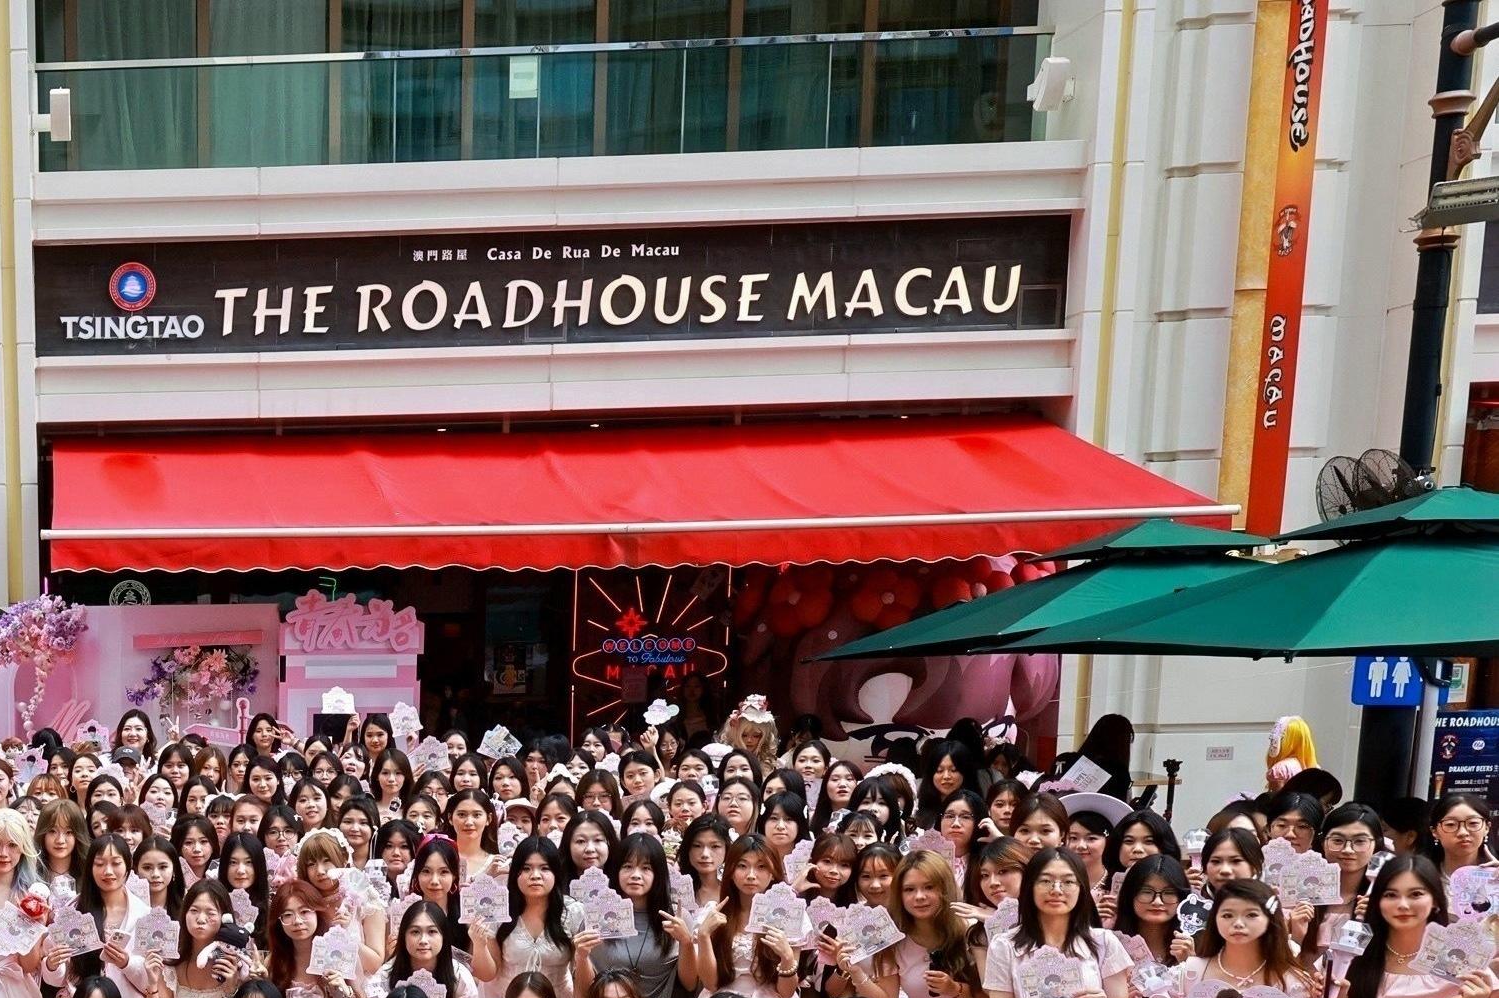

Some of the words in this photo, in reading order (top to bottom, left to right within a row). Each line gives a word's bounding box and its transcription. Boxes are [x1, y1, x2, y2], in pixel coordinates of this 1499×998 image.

[1289, 0, 1315, 152] ADHOUSE
[412, 249, 468, 261] 澳門路屋
[487, 247, 522, 260] Casa
[532, 247, 552, 259] De
[562, 246, 590, 259] Rua
[601, 245, 621, 258] De
[631, 243, 680, 257] Macau
[214, 285, 334, 337] THE
[355, 272, 770, 334] ROADHOUSE
[786, 264, 1023, 321] MACAU
[59, 314, 205, 340] TSINGTAO
[1263, 314, 1287, 430] MACAU
[602, 637, 696, 654] WELCOME
[641, 652, 686, 663] Fabulous
[1434, 717, 1448, 728] HE
